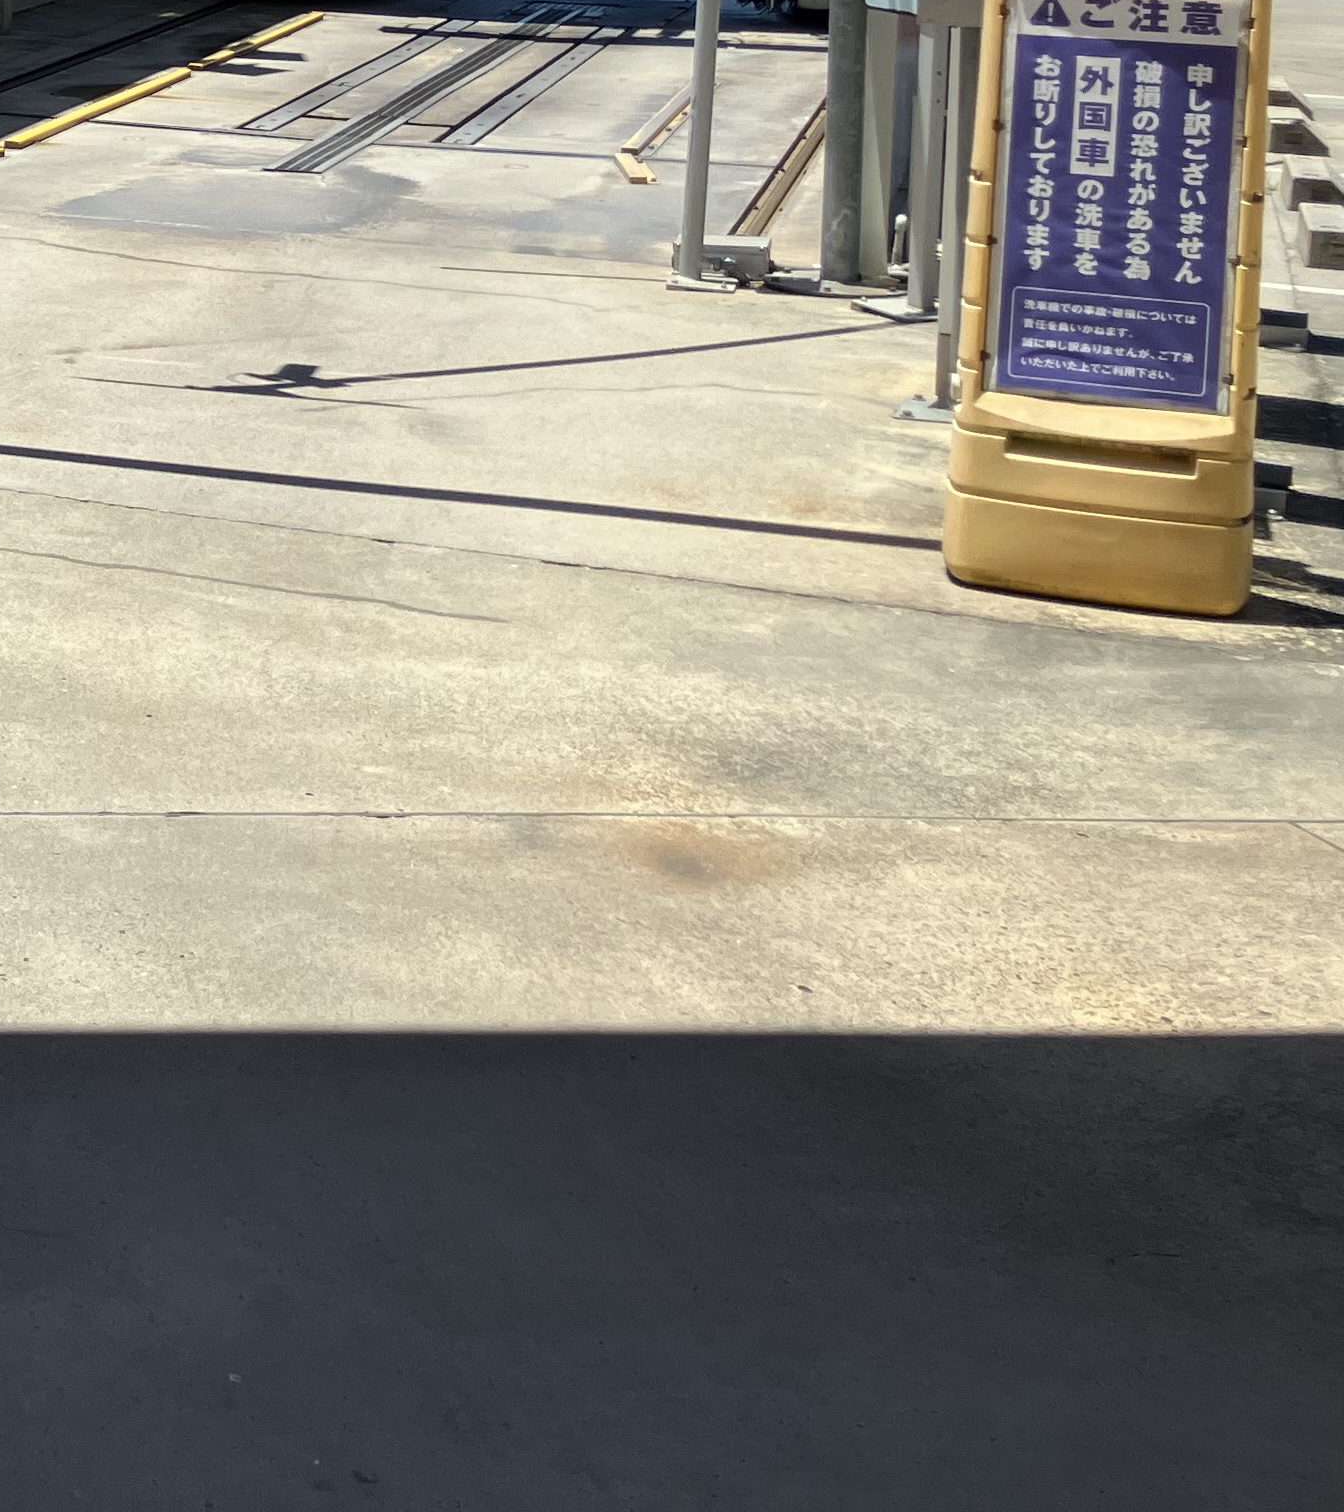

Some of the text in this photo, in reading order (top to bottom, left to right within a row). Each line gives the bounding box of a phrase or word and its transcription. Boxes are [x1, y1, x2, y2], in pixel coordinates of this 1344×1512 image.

[1023, 54, 1063, 271] お断りしております
[1073, 64, 1115, 276] 外国車の洗車を
[1123, 60, 1163, 281] 破損の恐れがある為
[1174, 63, 1214, 285] 申し訳ございません
